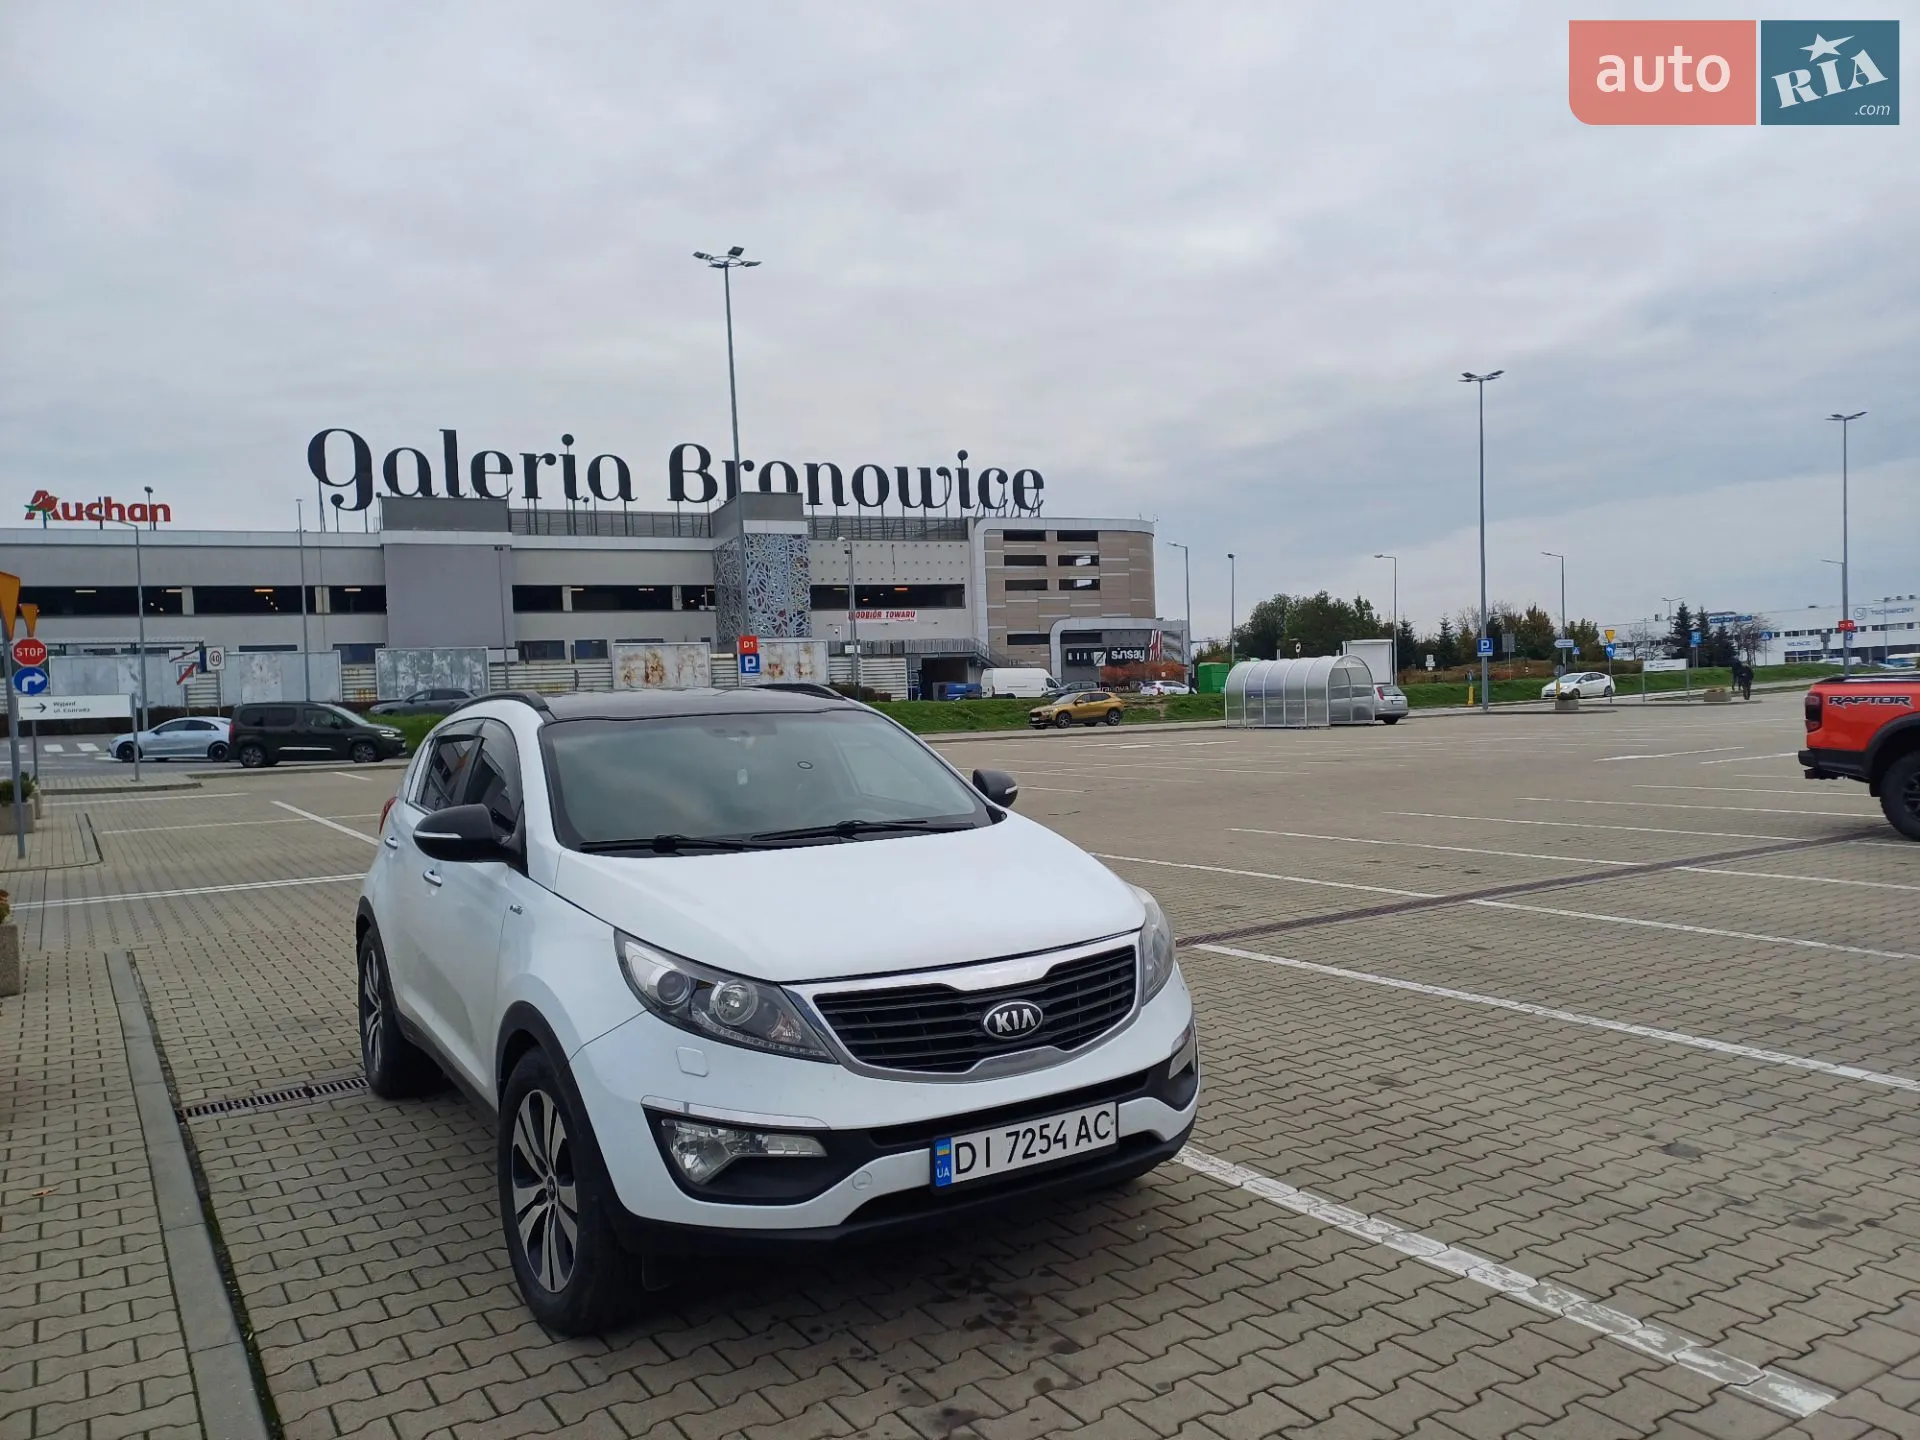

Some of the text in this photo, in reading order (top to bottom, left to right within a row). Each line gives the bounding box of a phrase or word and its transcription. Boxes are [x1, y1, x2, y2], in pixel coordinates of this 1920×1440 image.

[307, 428, 1044, 511] galeria Bronowice
[24, 489, 171, 522] Auchan
[886, 610, 916, 618] TOWARU
[743, 640, 754, 649] D1
[1480, 639, 1490, 652] P
[16, 647, 44, 657] STOP
[1111, 647, 1145, 662] sinsay
[744, 655, 757, 672] P
[1828, 696, 1914, 709] RAPTOR
[993, 1008, 1037, 1033] KIA
[954, 1110, 1111, 1175] DI 7254 AC
[936, 1167, 950, 1179] UA
